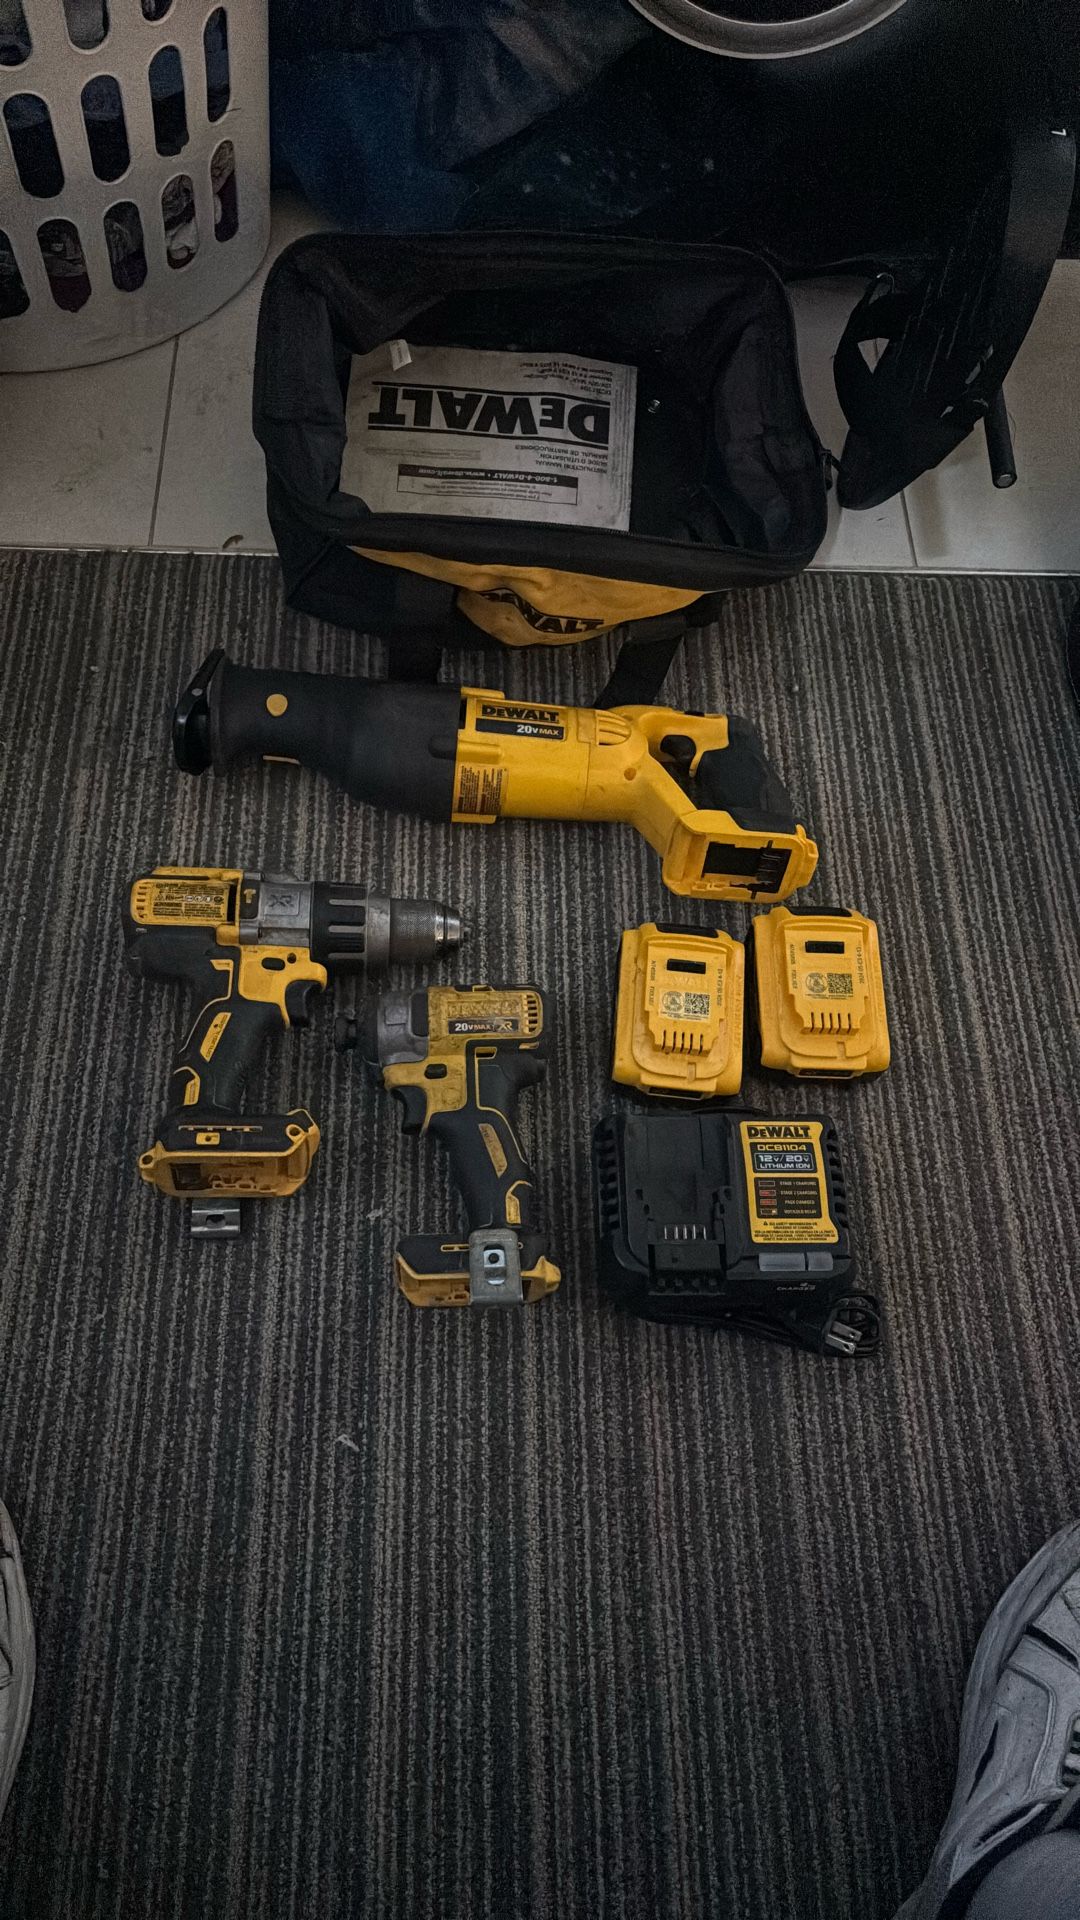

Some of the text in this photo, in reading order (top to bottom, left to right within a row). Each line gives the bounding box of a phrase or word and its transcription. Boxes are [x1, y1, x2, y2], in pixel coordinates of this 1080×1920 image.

[367, 386, 609, 444] DEWALT
[481, 704, 560, 723] DEWALT
[539, 728, 560, 736] MAX
[746, 1125, 811, 1138] DEWALT
